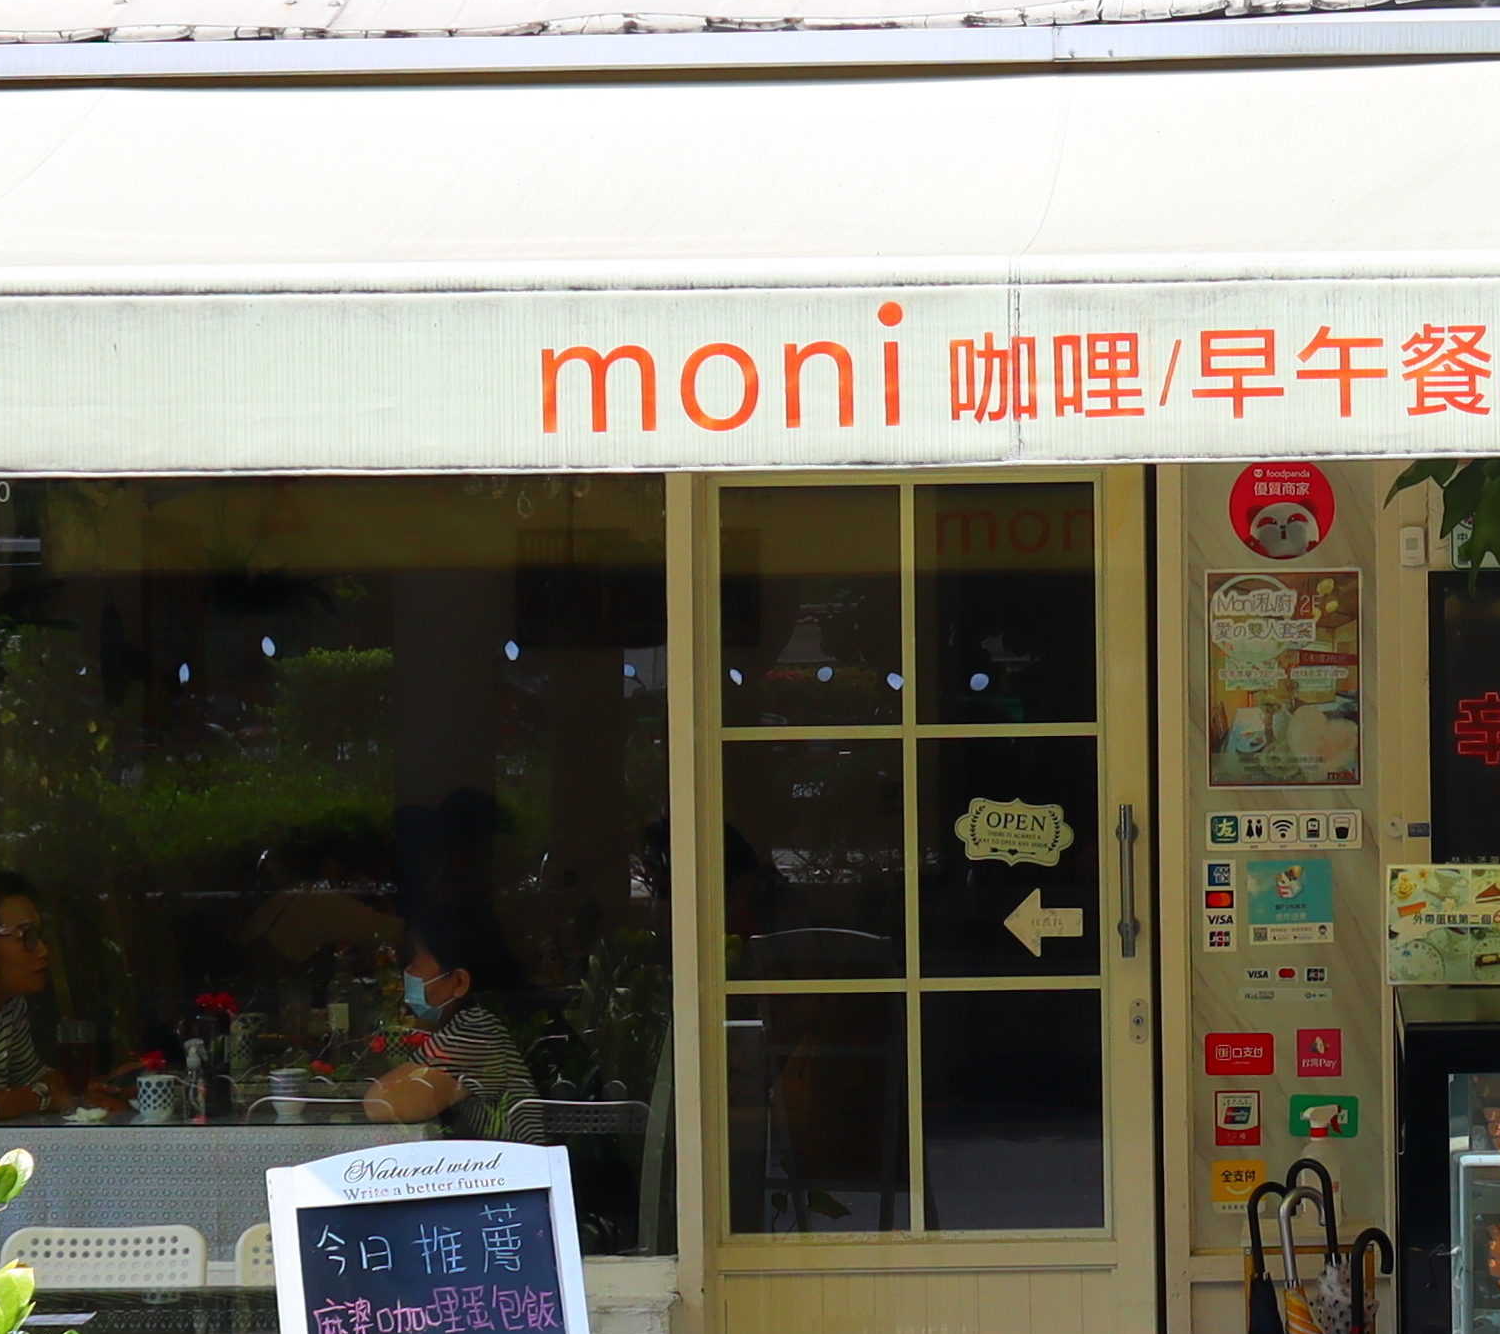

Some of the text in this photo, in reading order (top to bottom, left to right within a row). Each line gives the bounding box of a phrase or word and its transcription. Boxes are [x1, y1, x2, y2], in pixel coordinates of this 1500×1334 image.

[541, 300, 904, 433] moni
[1266, 469, 1311, 480] foodpanda
[1254, 481, 1310, 496] 優質商家
[986, 811, 1047, 833] OPEN
[1208, 915, 1234, 925] VISA
[1247, 970, 1269, 979] VISA
[1215, 1044, 1264, 1061] 街口支付
[343, 1152, 502, 1185] Natural wind
[1222, 1169, 1257, 1183] 全支付
[343, 1185, 389, 1202] Write
[406, 1179, 452, 1196] better
[456, 1175, 507, 1191] future
